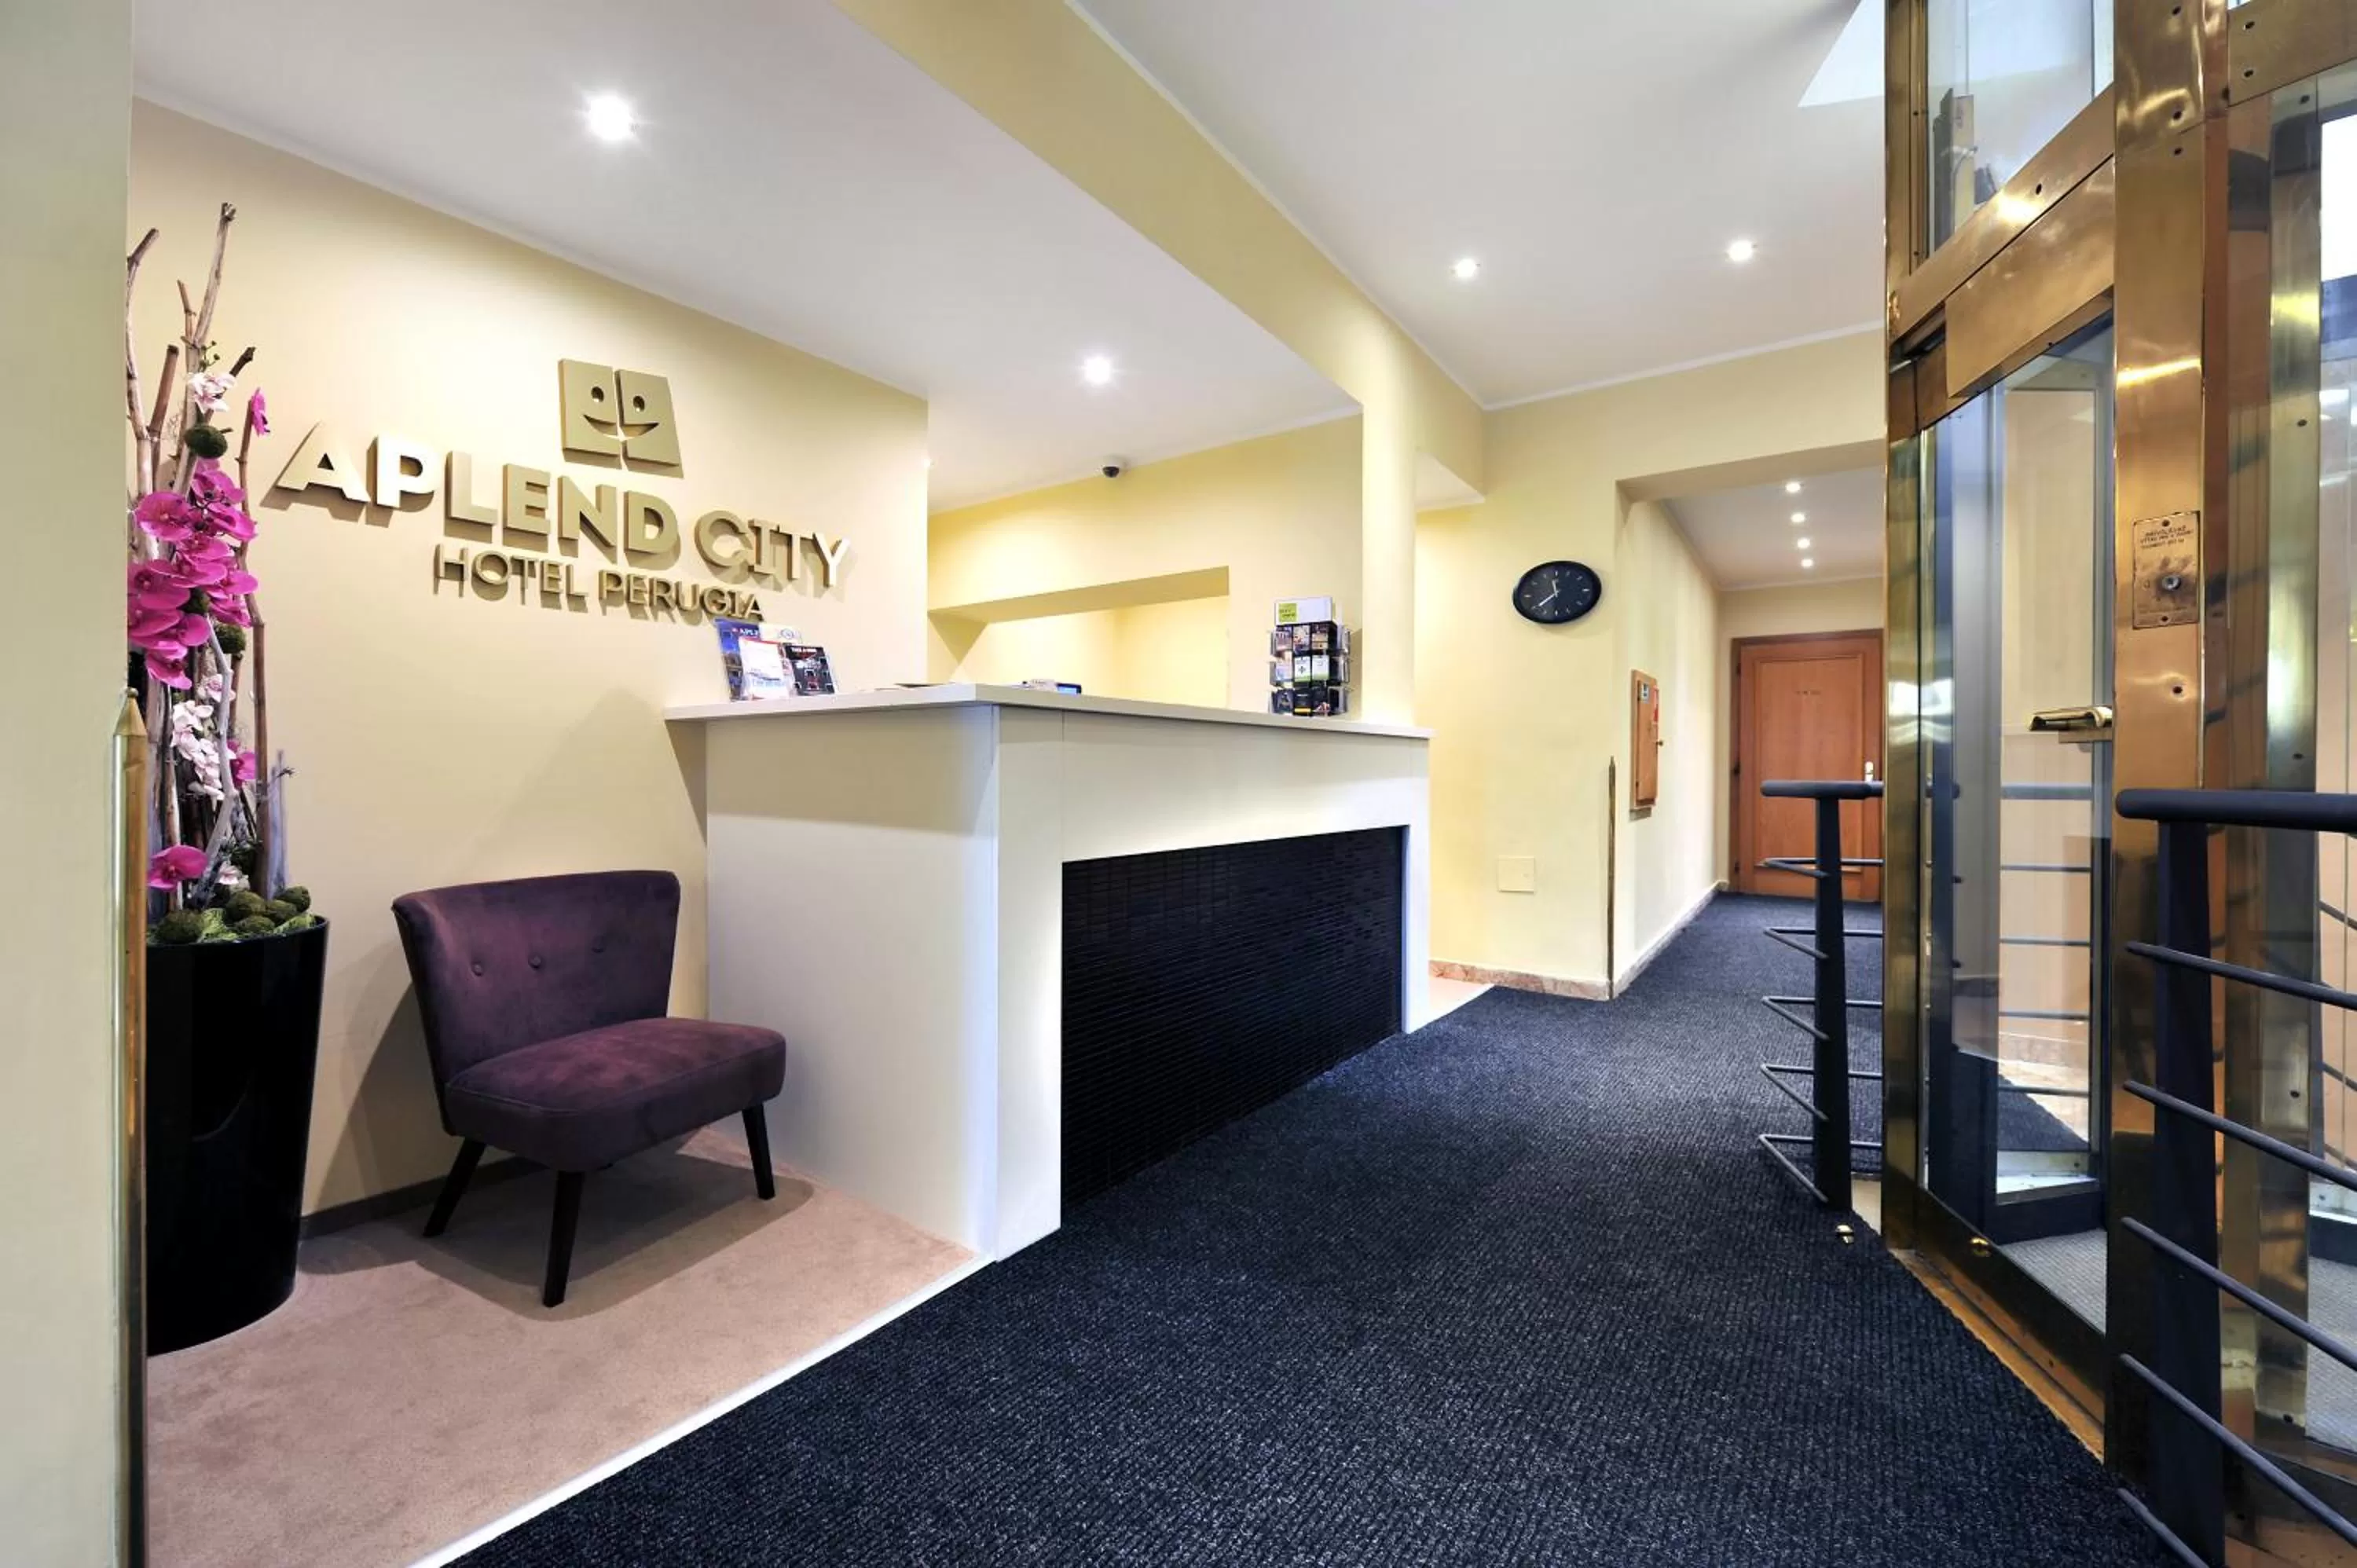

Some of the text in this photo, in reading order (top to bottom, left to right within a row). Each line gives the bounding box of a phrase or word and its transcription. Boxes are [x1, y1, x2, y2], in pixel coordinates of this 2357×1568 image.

[272, 419, 850, 588] APLEND CITY
[434, 544, 764, 621] HOTEL PERUGIA
